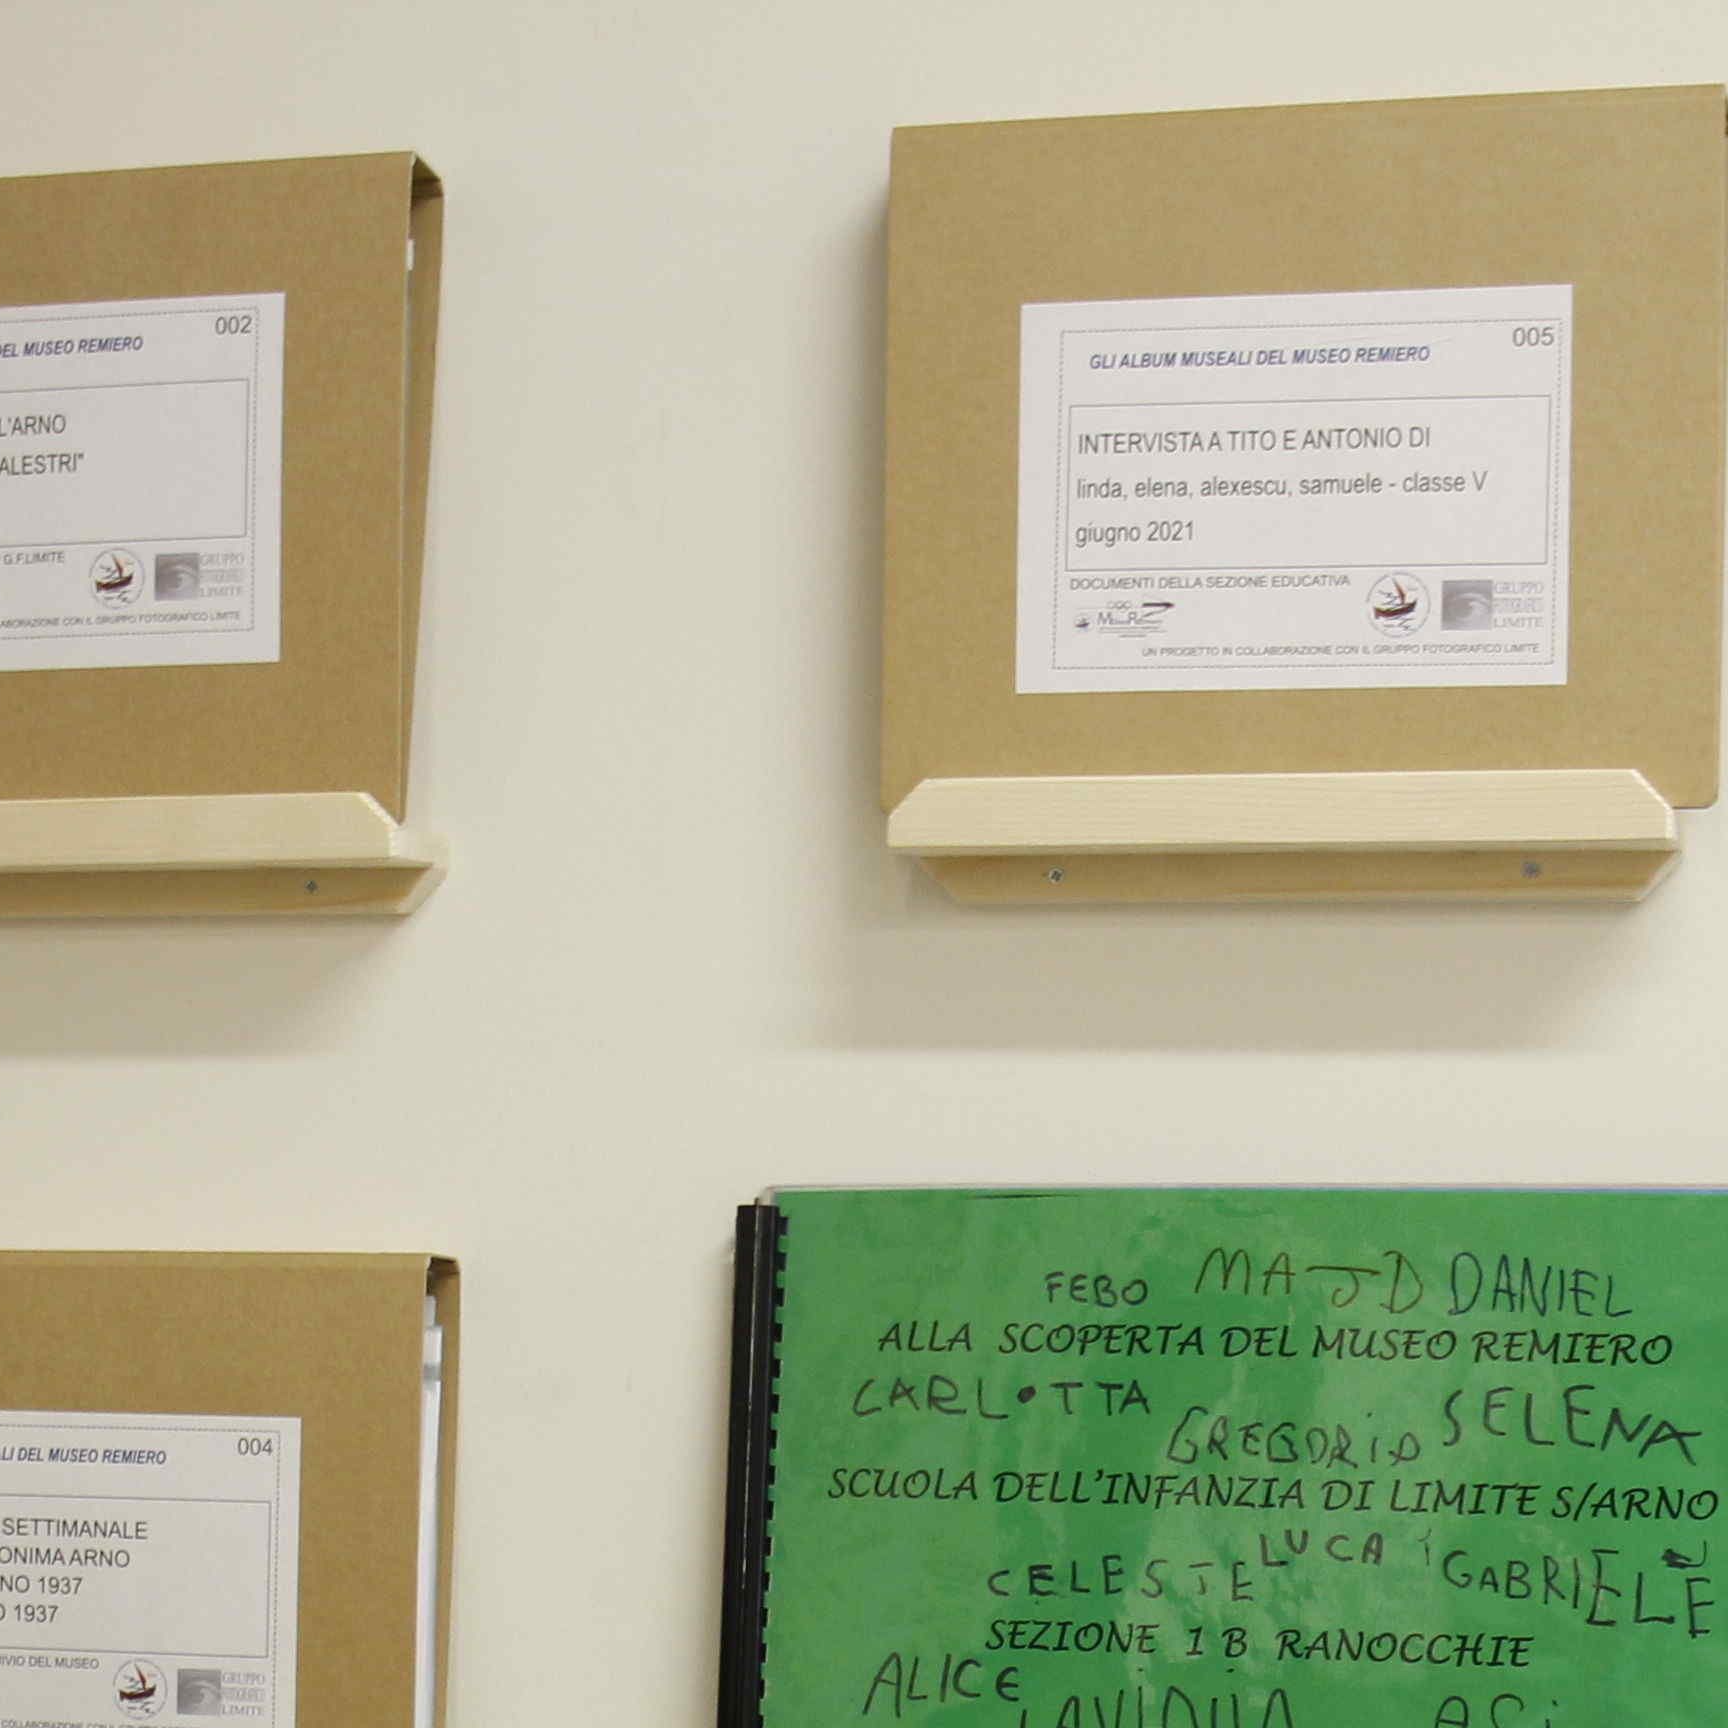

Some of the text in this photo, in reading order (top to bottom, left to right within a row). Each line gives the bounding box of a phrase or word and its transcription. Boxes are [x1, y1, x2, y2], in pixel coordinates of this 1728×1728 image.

[215, 316, 252, 335] 002
[1513, 327, 1554, 346] 005
[24, 339, 73, 357] MUSEO
[78, 336, 143, 353] REMIERO
[1078, 426, 1430, 454] INTERVISTA A TITO E ANTONIO DI
[1077, 471, 1488, 500] linda, elena, alexescu, samuele classe V
[1076, 521, 1194, 548] giugno 2021
[1045, 1272, 1148, 1308] FEBO
[1449, 1251, 1633, 1318] DANIEL
[878, 1322, 1672, 1366] ALLA SCOPERTA DEL MUSEO REMIERO
[1443, 1385, 1702, 1466] SELENA
[237, 1438, 273, 1456] 004
[828, 1468, 1720, 1521] SCUOLA DELL'INFANZIA DI LIMITE S/ARNO
[2, 1518, 148, 1540] SETTIMANALE
[69, 1548, 129, 1568] ARNO
[1261, 1530, 1382, 1569] LUCA
[38, 1576, 82, 1595] 1937
[988, 1556, 1253, 1601] CELESTE
[1443, 1548, 1715, 1639] GABRIELE
[14, 1604, 58, 1623] 1937
[986, 1619, 1534, 1668] SEZIONE 1 B RANOCCHIE
[862, 1653, 1021, 1717] ALICE
